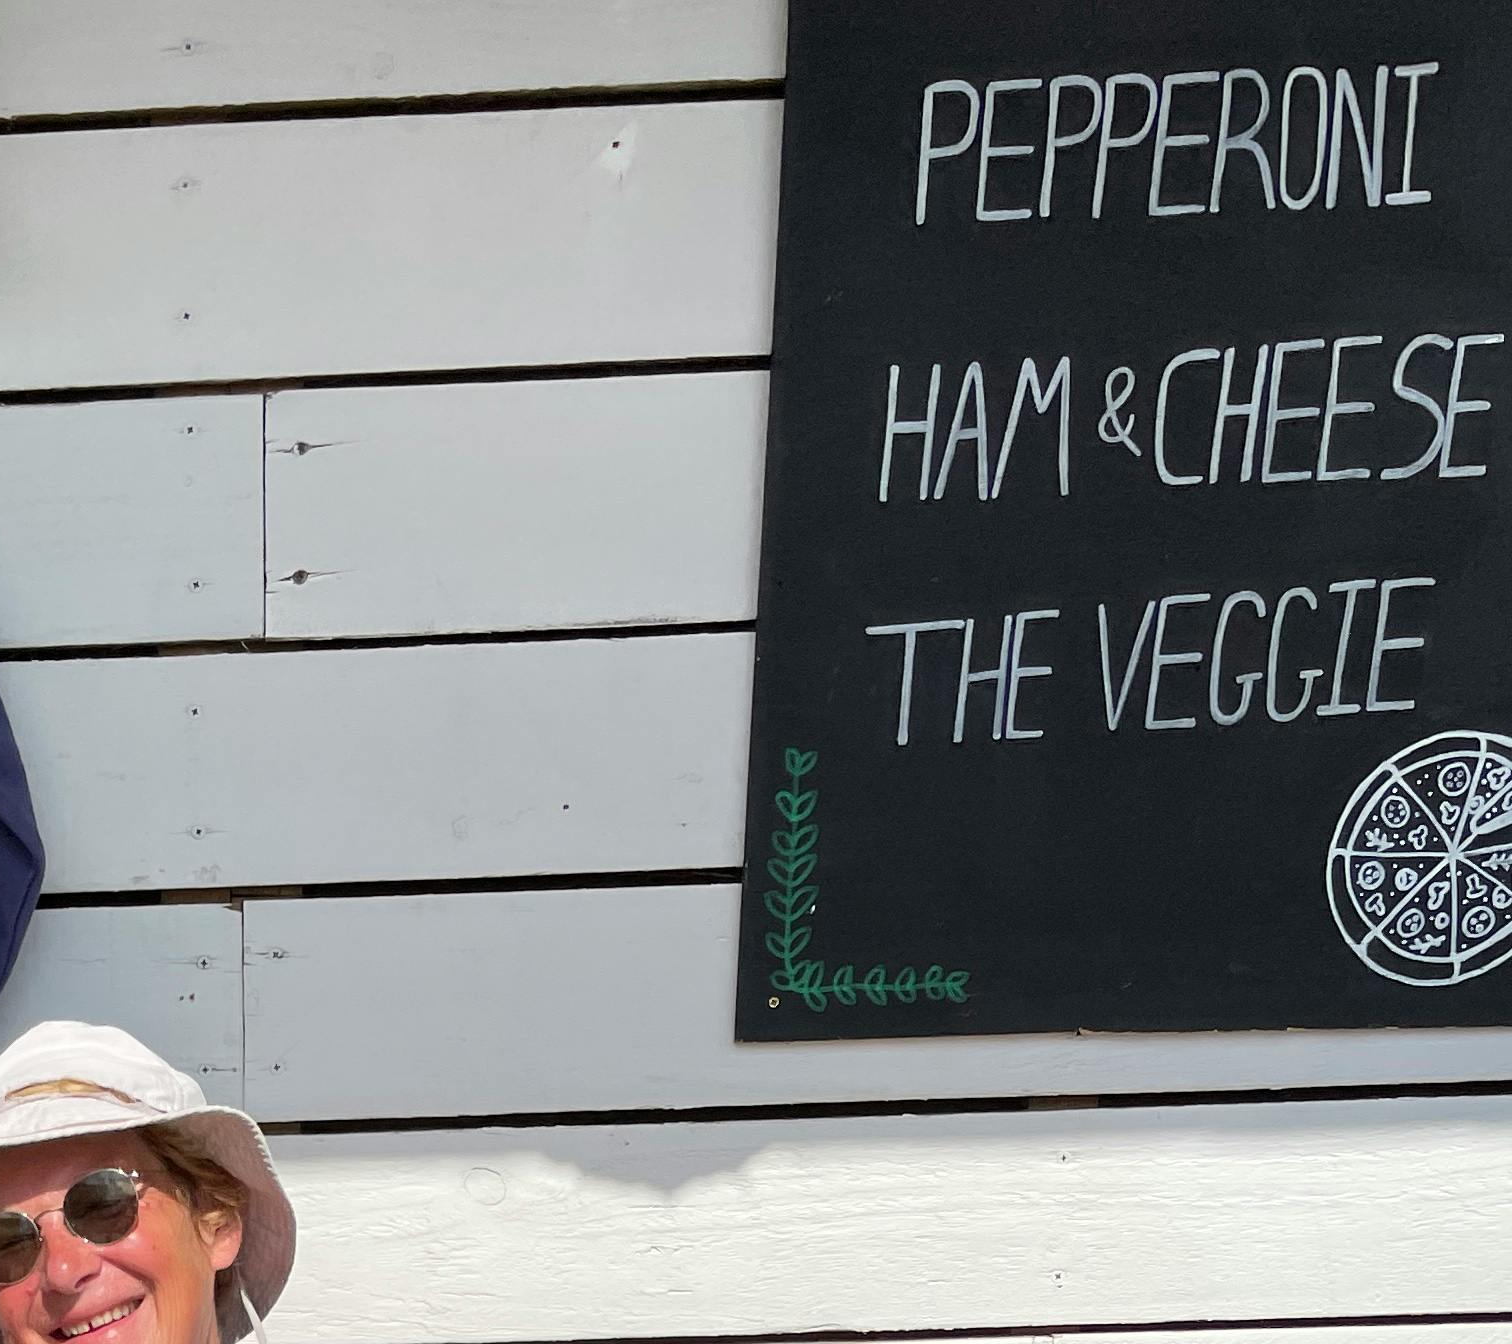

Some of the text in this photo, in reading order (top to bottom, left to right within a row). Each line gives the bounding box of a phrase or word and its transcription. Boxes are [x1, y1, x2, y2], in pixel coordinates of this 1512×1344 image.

[915, 61, 1439, 226] PEPPERONI
[879, 333, 1505, 503] HAM & CHEESE
[865, 577, 1436, 746] THE VEGGIE
